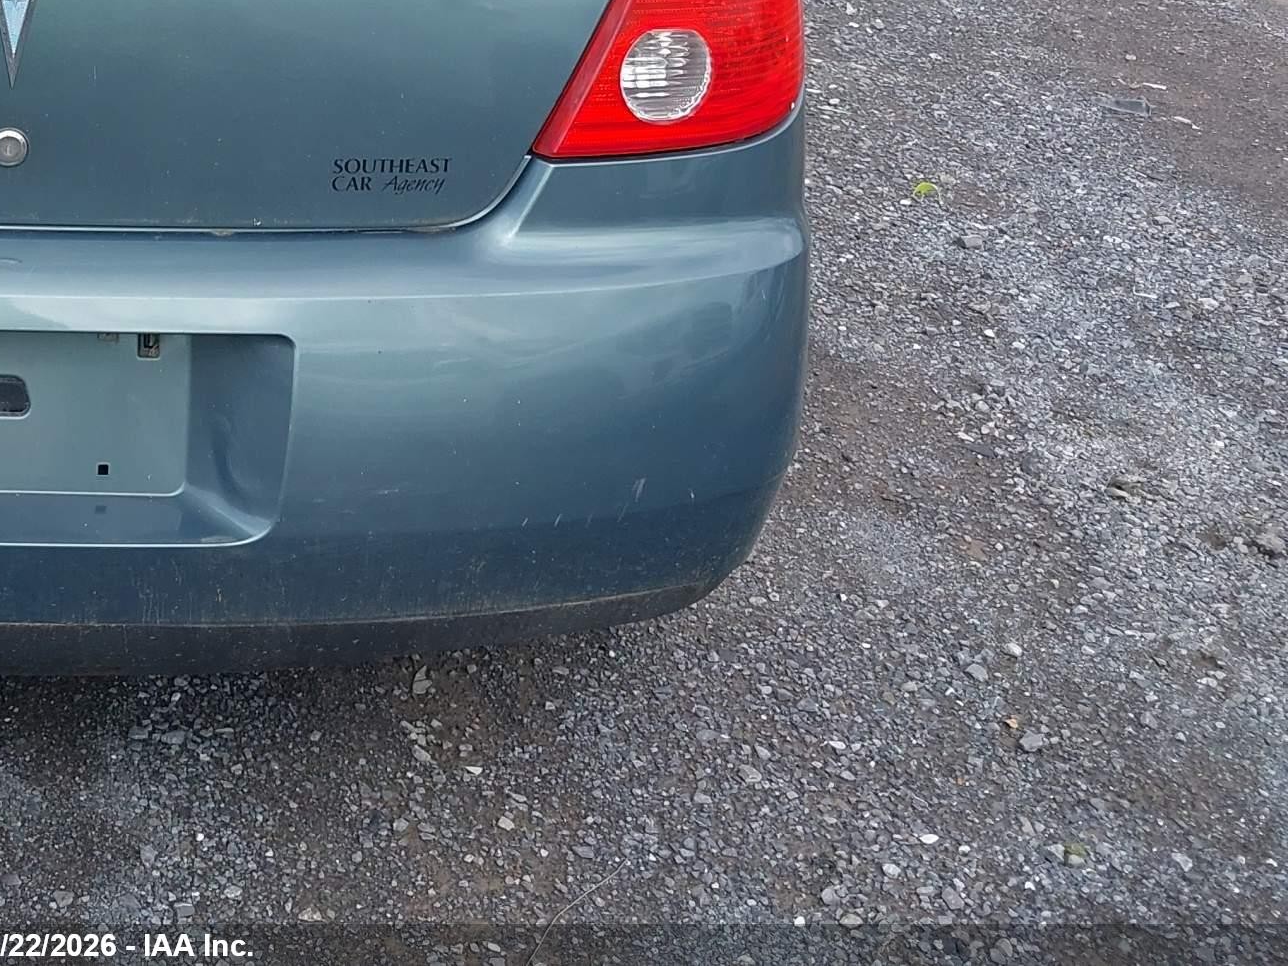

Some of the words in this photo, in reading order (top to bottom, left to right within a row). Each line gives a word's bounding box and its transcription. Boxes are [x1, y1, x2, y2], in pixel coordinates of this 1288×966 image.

[332, 158, 452, 174] SOUTHEAST
[332, 175, 372, 192] CAR
[382, 175, 445, 195] Agency
